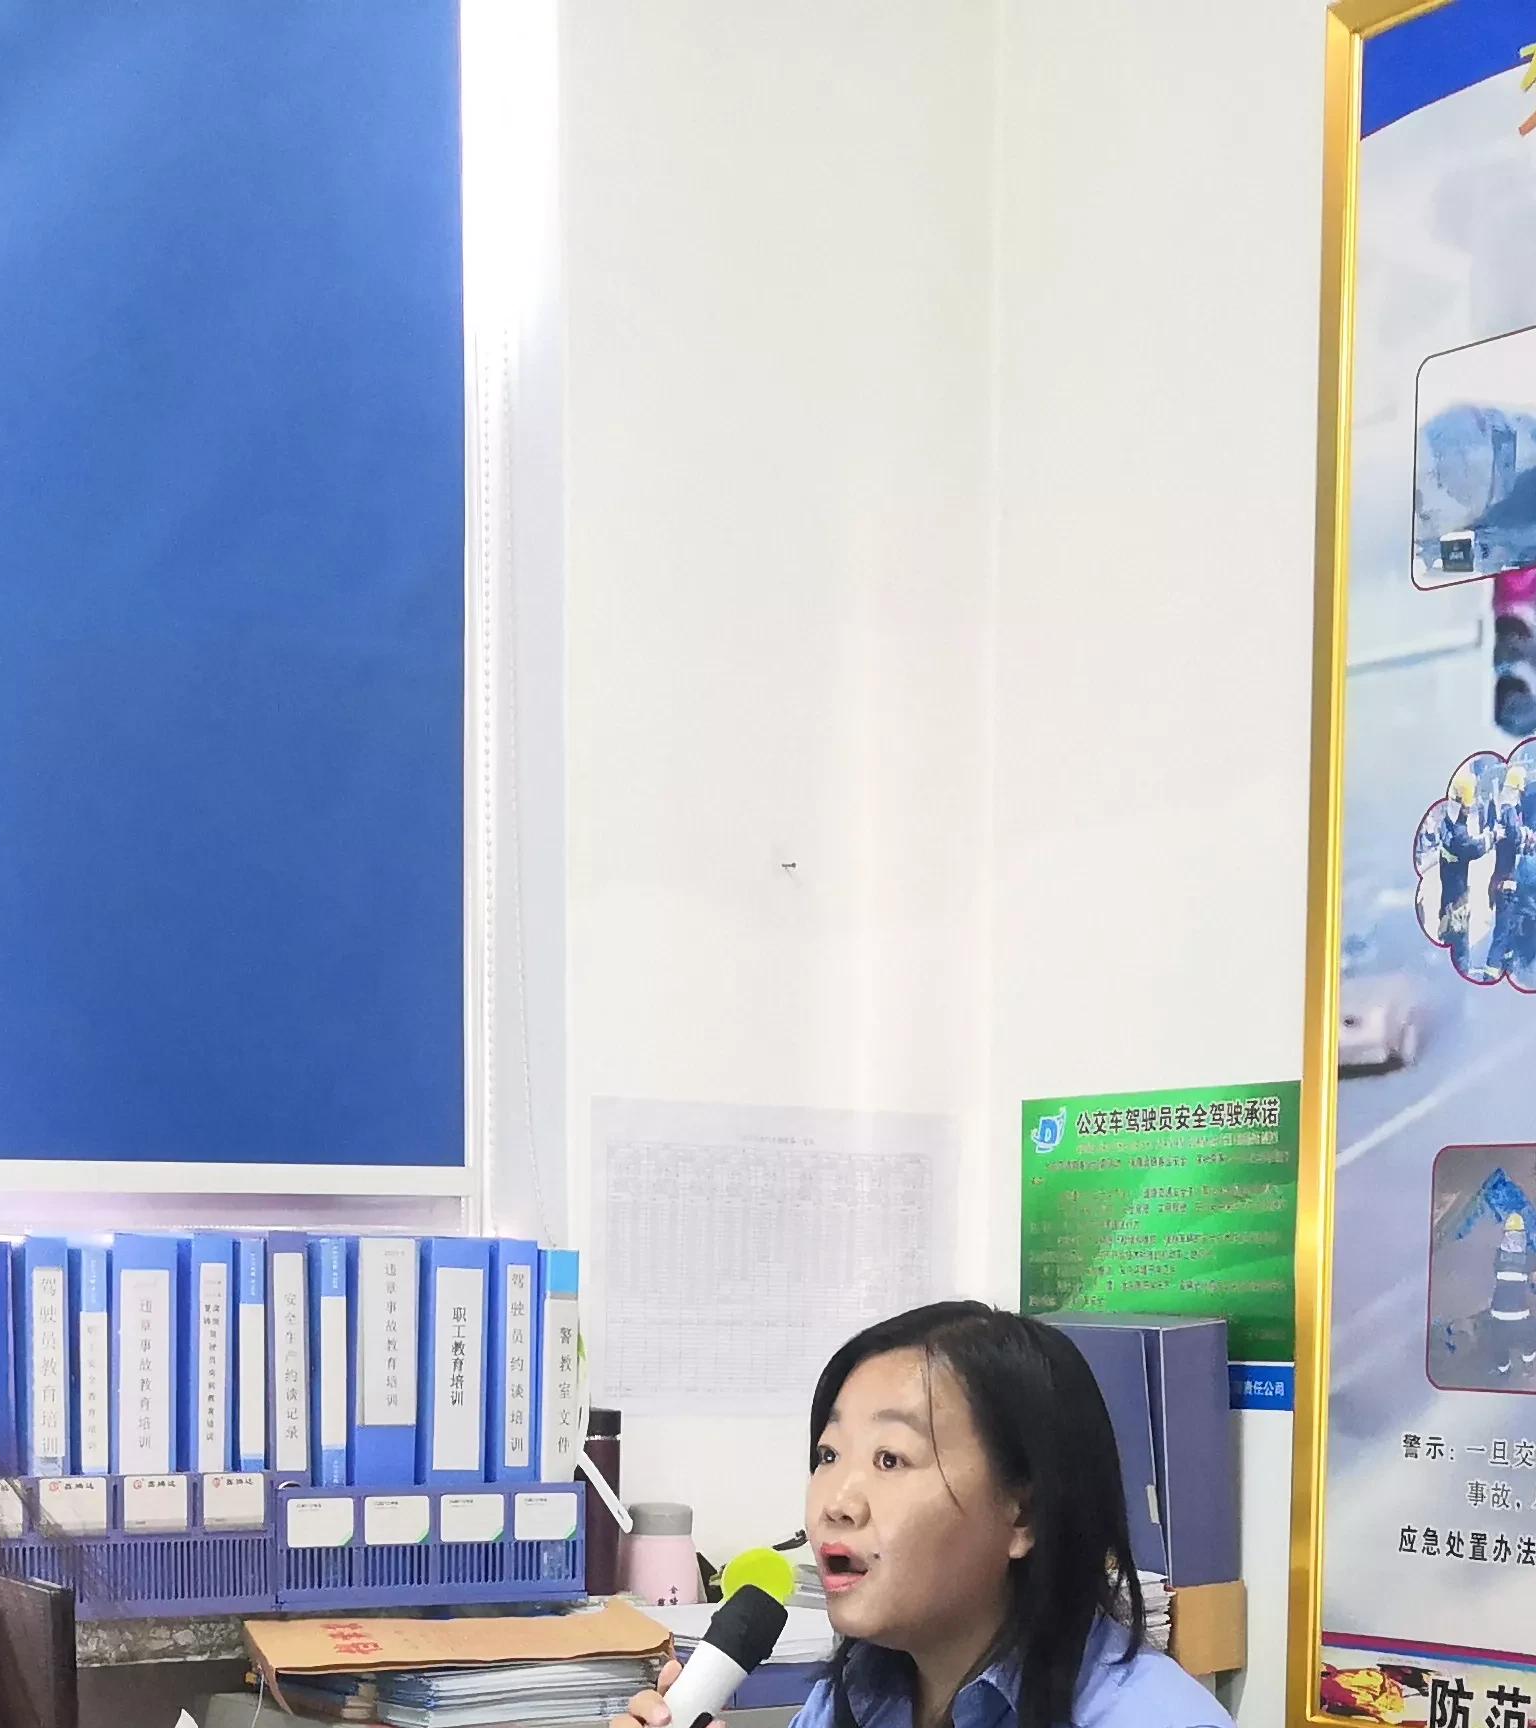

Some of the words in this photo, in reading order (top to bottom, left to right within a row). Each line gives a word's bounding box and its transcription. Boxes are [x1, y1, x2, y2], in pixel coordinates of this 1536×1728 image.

[1076, 1098, 1280, 1136] 公交车驾驶员安全驾驶承诺
[450, 1306, 467, 1407] 职工教育培训
